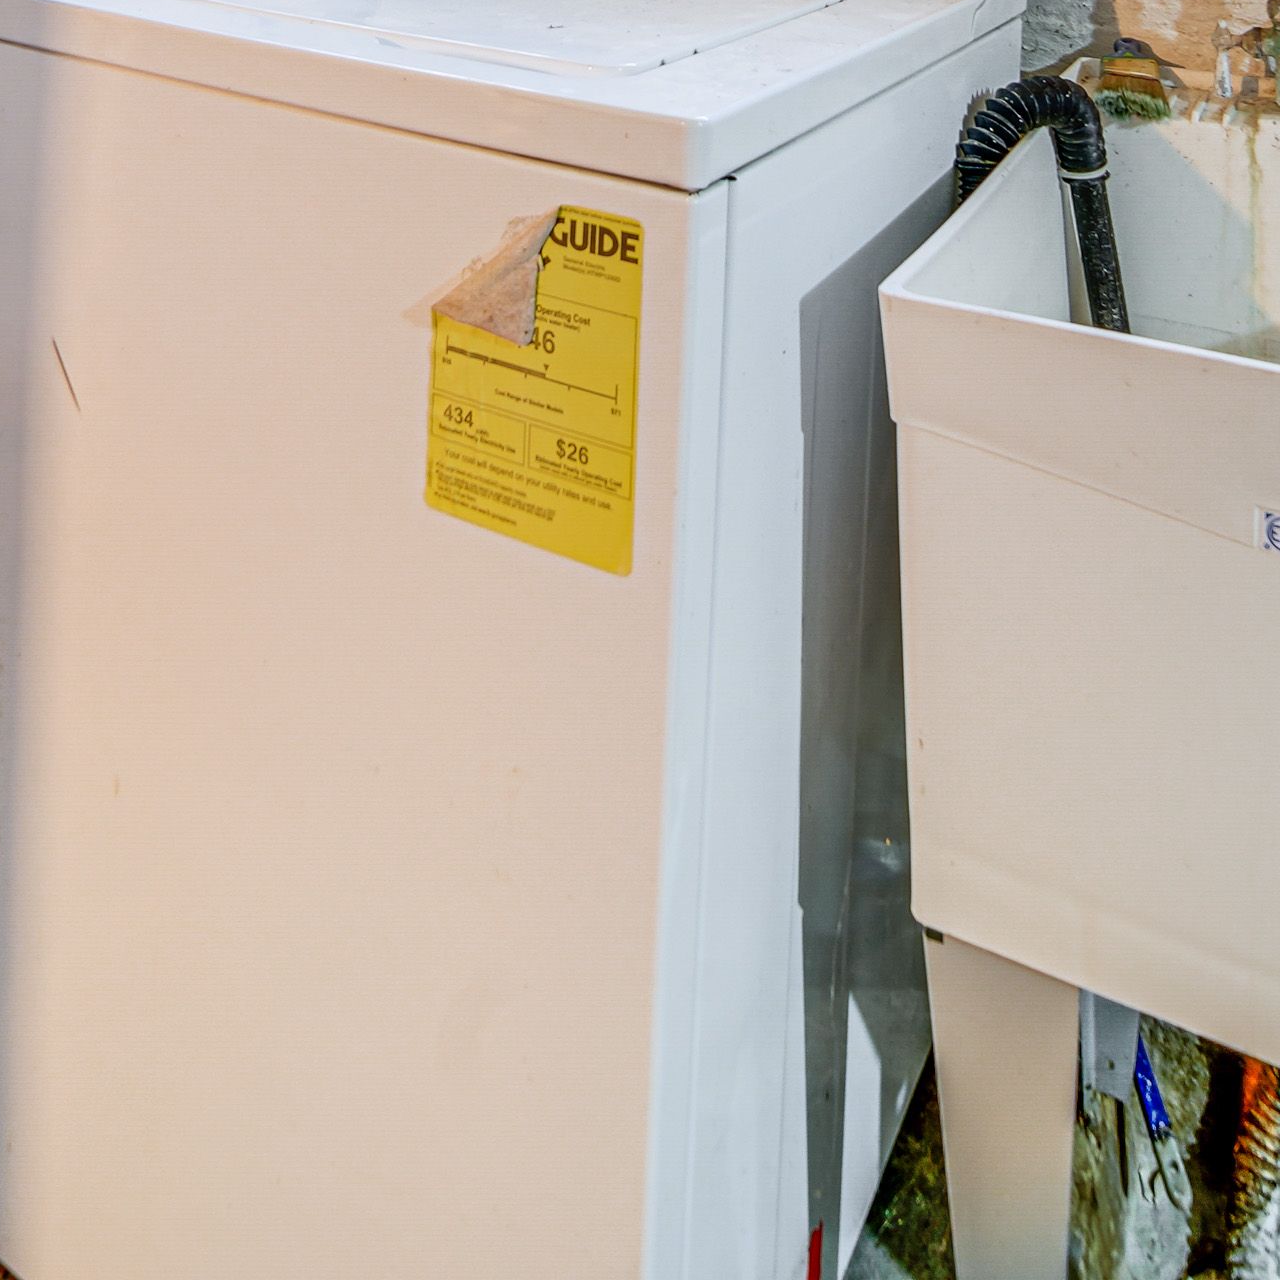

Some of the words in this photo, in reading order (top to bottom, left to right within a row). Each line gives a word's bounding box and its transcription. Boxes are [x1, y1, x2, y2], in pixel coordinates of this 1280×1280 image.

[549, 218, 639, 265] GUIDE
[536, 304, 571, 323] Operating
[573, 313, 591, 326] Cost
[443, 404, 474, 428] 434
[556, 438, 589, 465] $26
